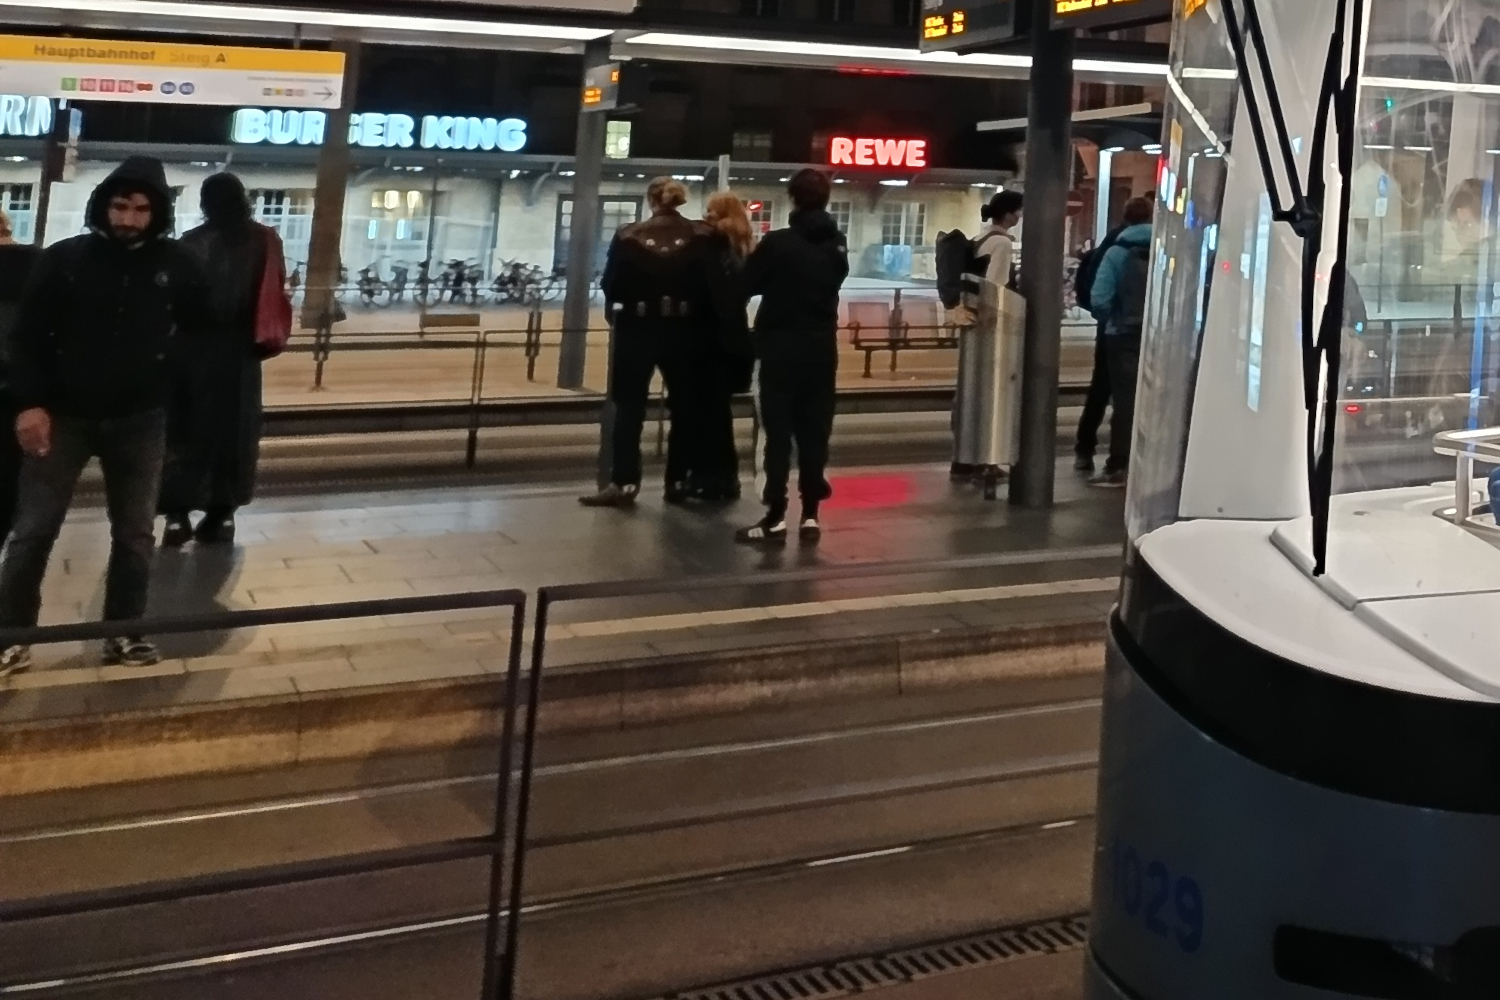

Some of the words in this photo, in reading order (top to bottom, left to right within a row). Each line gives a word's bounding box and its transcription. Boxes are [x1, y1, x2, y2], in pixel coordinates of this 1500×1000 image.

[33, 44, 157, 61] Hauptbahnhof
[169, 52, 210, 67] Steig
[215, 52, 227, 63] A
[231, 108, 415, 149] BURER
[421, 114, 528, 152] KING
[831, 136, 927, 168] REWE
